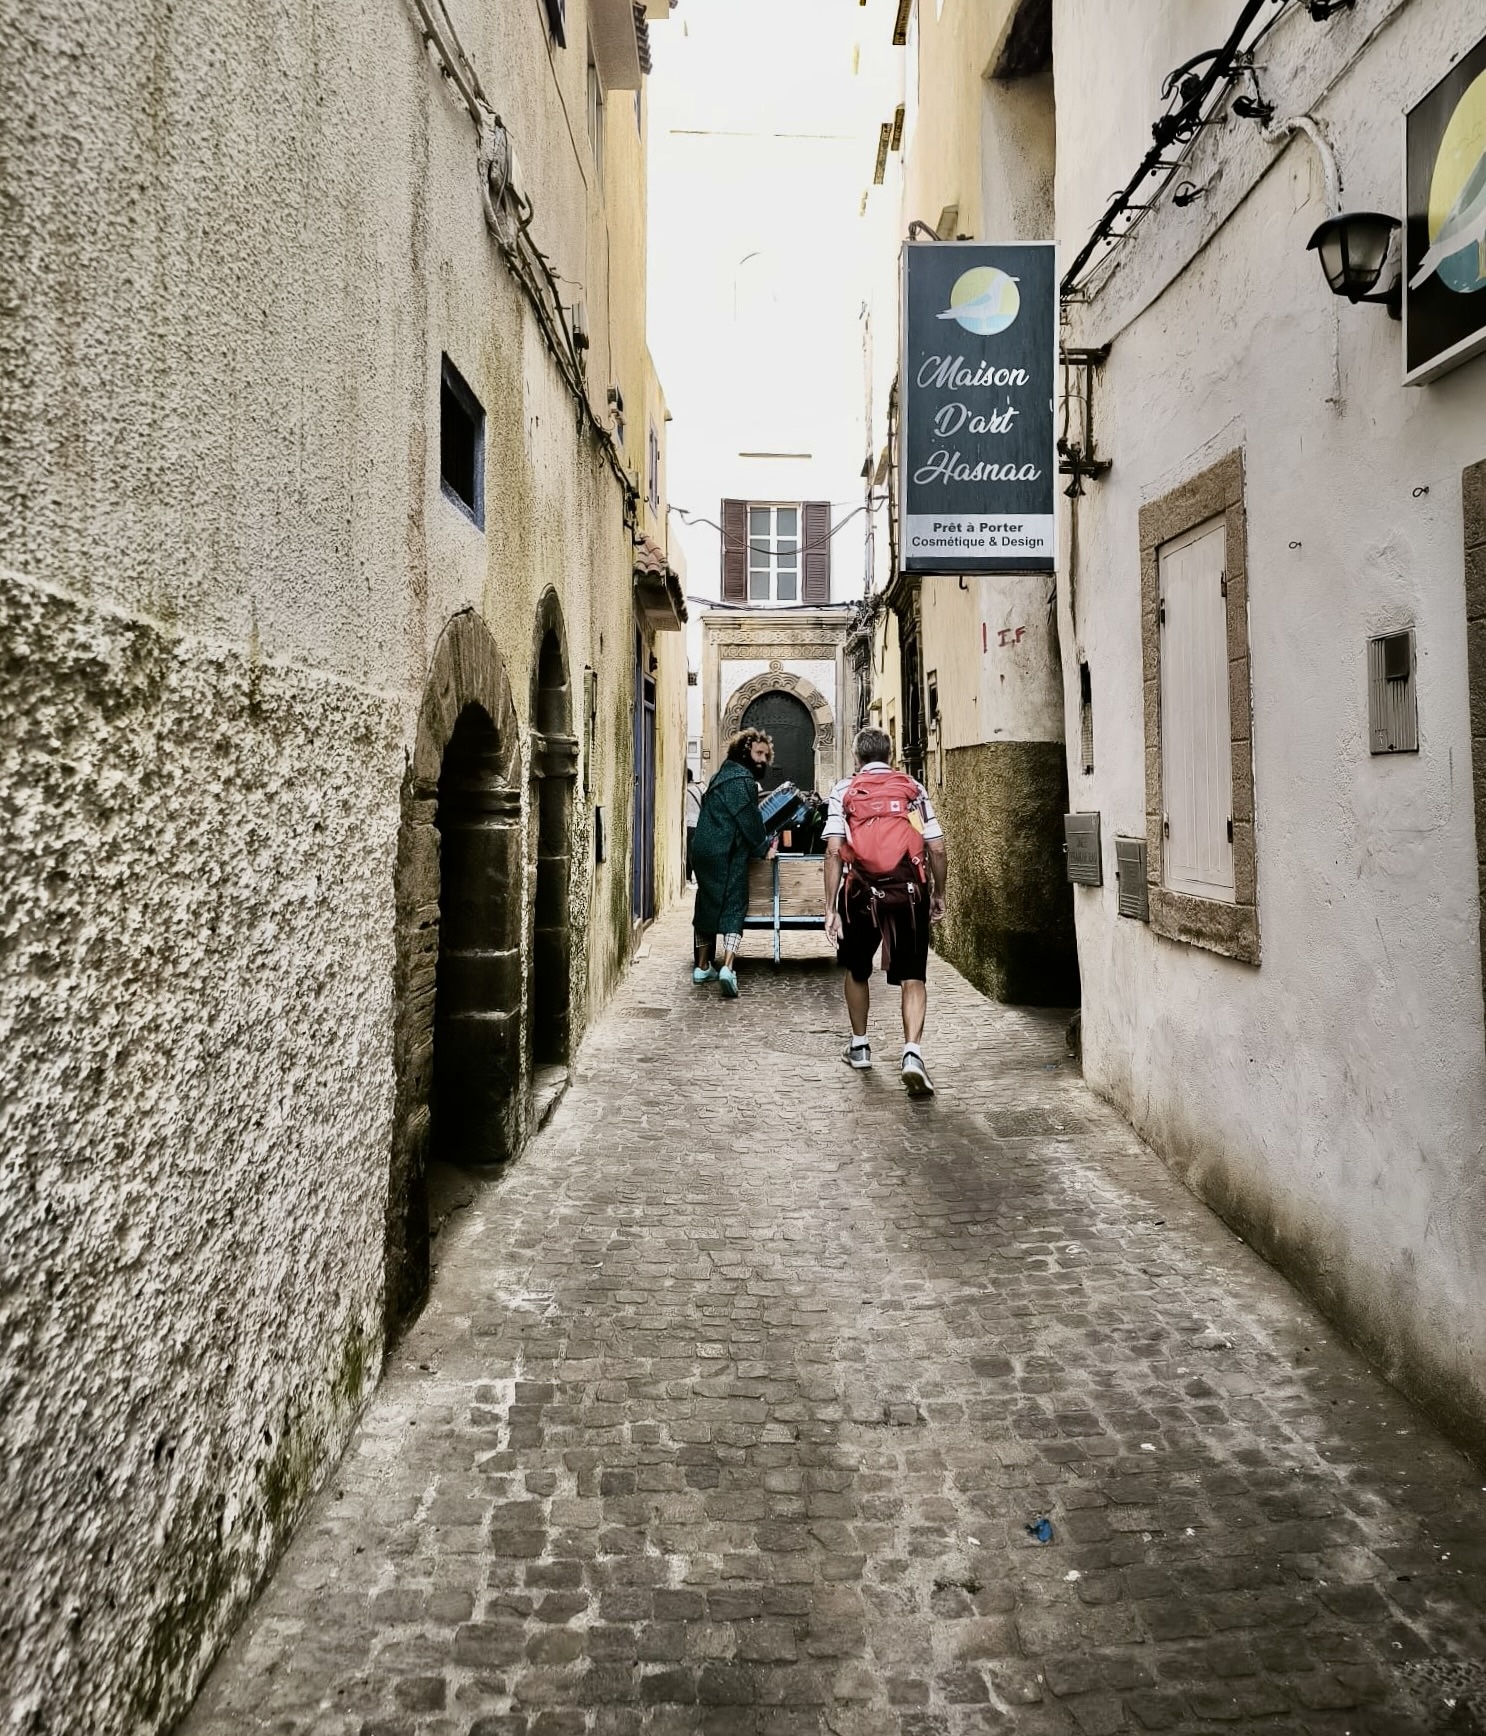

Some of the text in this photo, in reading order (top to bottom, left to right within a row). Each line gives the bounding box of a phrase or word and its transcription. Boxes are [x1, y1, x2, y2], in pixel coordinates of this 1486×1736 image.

[917, 355, 1030, 390] Maison
[934, 402, 1020, 437] D'art
[914, 450, 1042, 485] Hasnaa
[912, 536, 1044, 549] Cosmétique & Design
[933, 522, 1024, 532] Prêt à Porter
